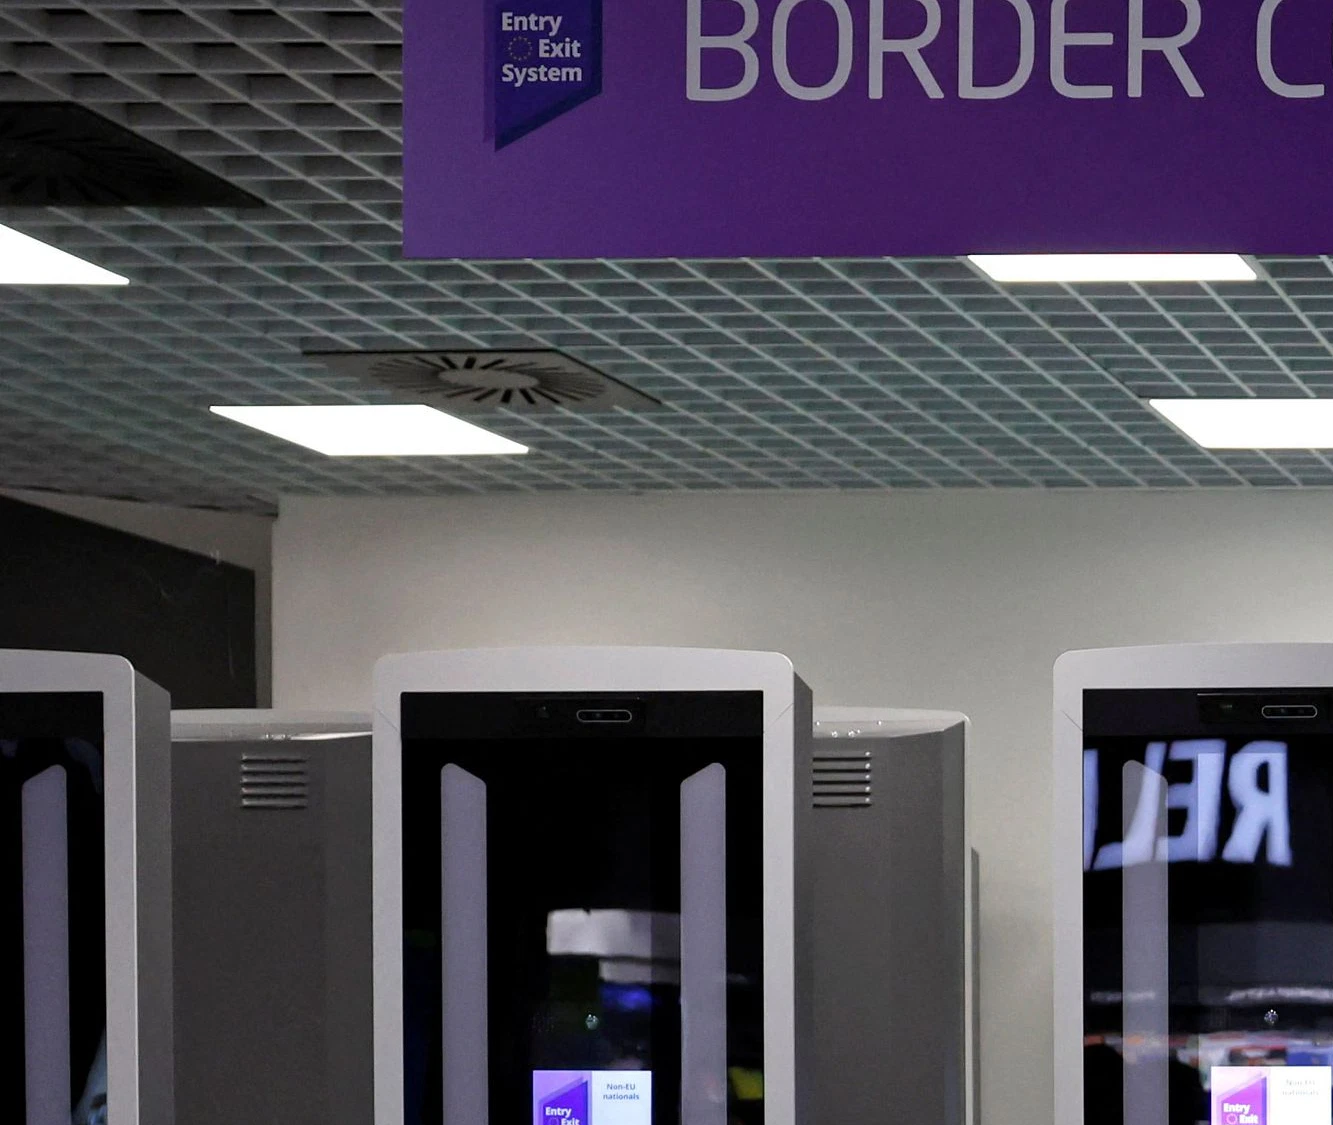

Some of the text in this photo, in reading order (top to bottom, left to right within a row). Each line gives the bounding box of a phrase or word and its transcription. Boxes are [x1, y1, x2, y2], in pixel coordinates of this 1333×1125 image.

[502, 12, 562, 36] Entry
[539, 37, 581, 58] Exit
[686, 0, 1205, 100] BORDER
[502, 64, 582, 87] System
[545, 1107, 572, 1117] Entry
[1223, 1103, 1250, 1115] Entry
